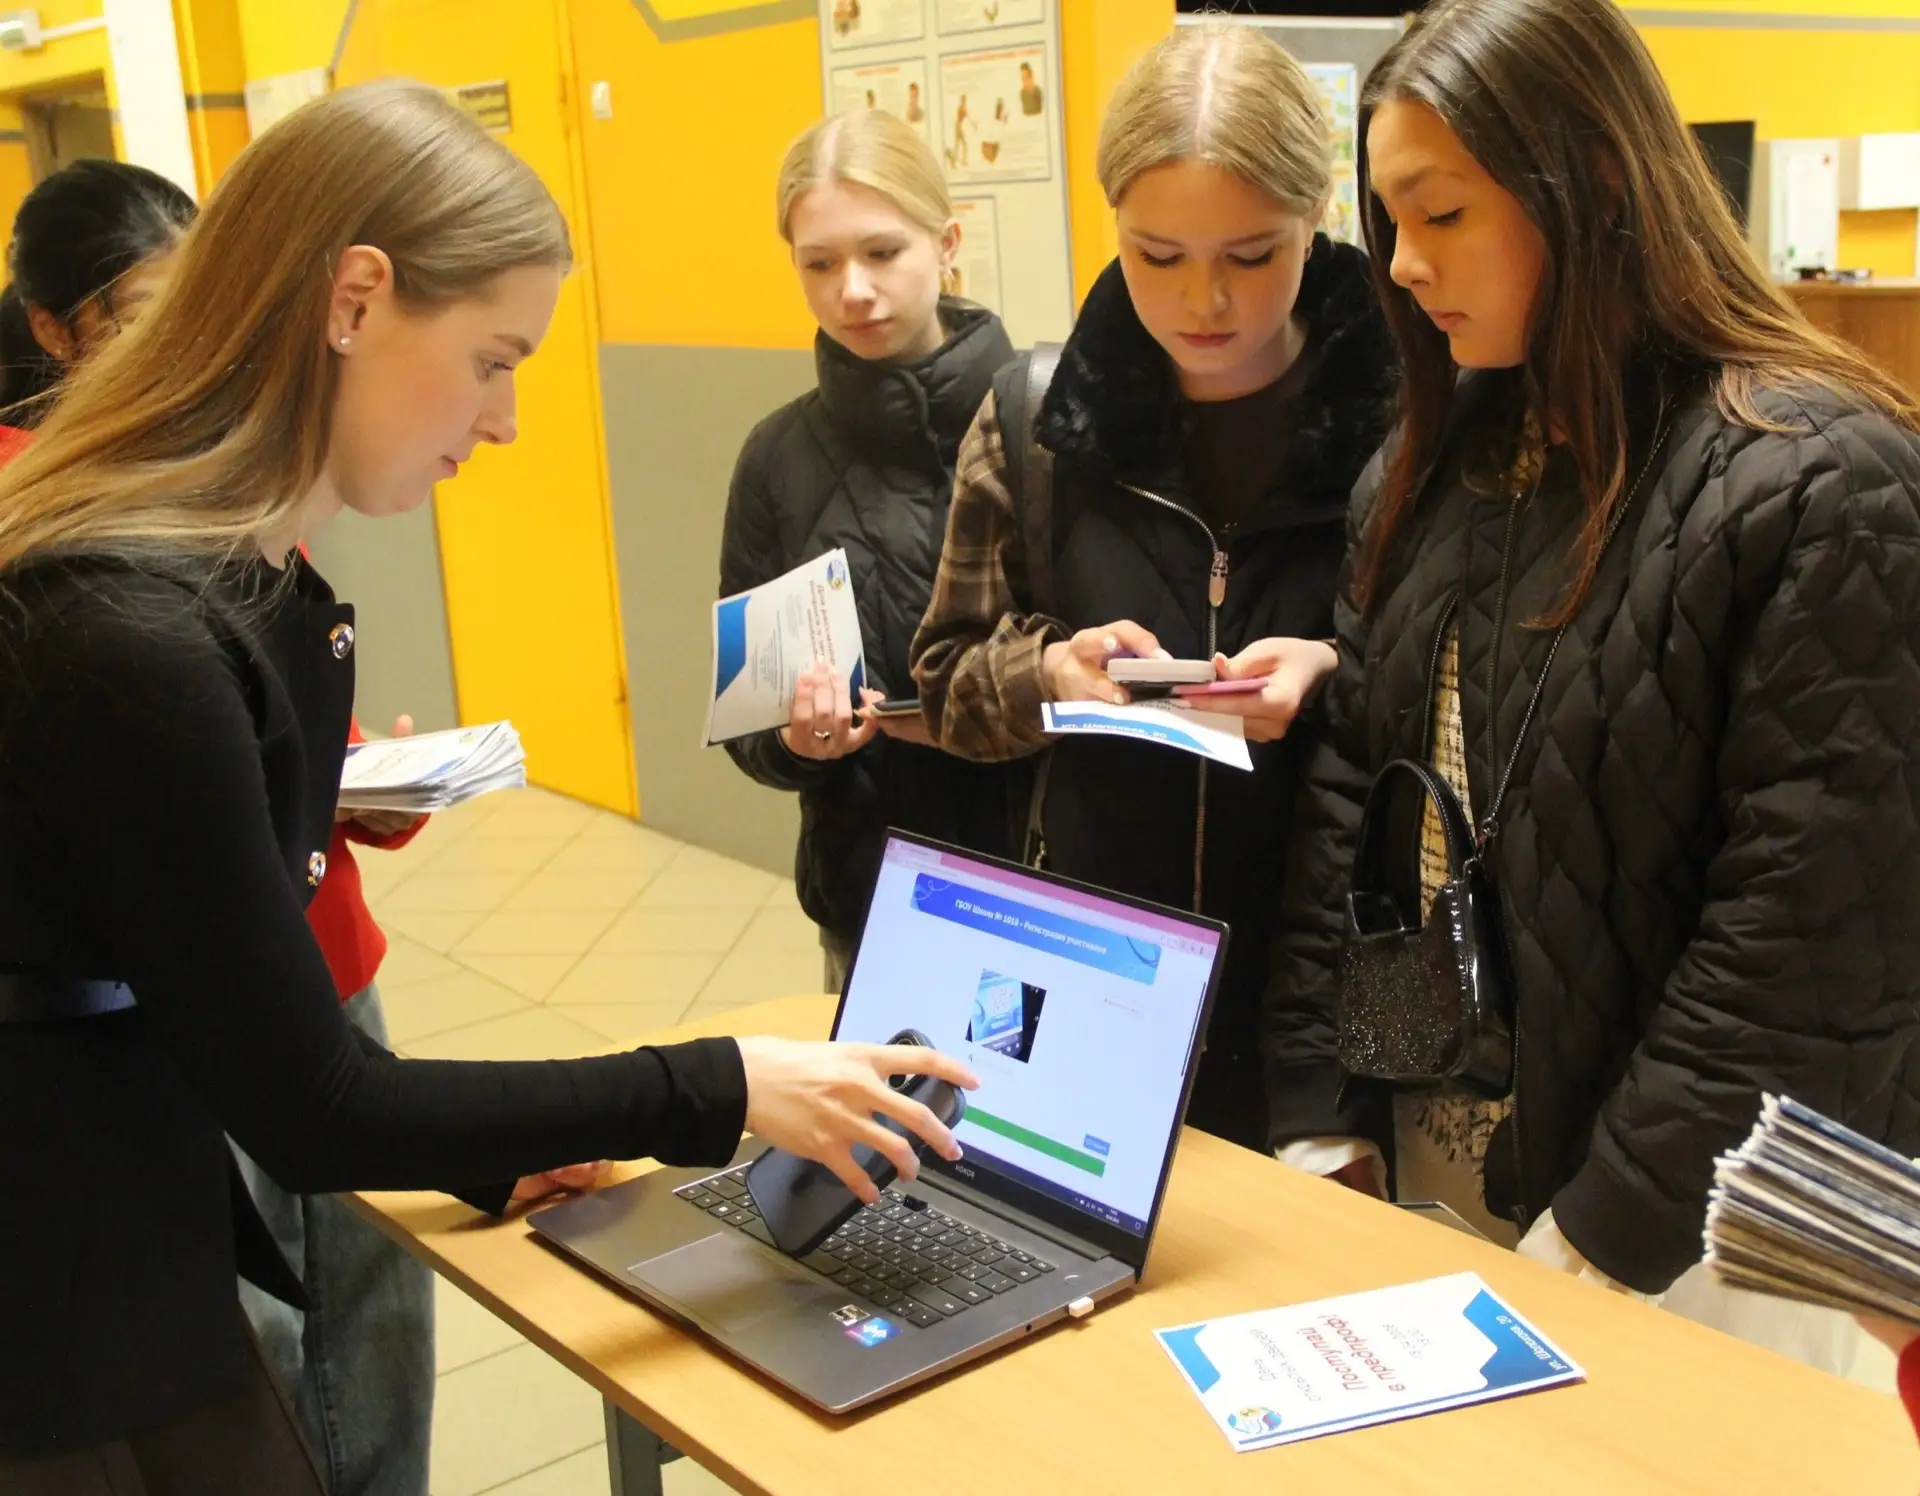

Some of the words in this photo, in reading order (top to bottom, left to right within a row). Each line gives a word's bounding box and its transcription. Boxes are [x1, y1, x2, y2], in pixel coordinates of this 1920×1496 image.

[955, 899, 971, 913] ГБОУ
[972, 904, 994, 919] Школа
[1296, 1327, 1369, 1390] Поступай
[1316, 1314, 1398, 1381] предпроф!
[1388, 1383, 1406, 1392] в
